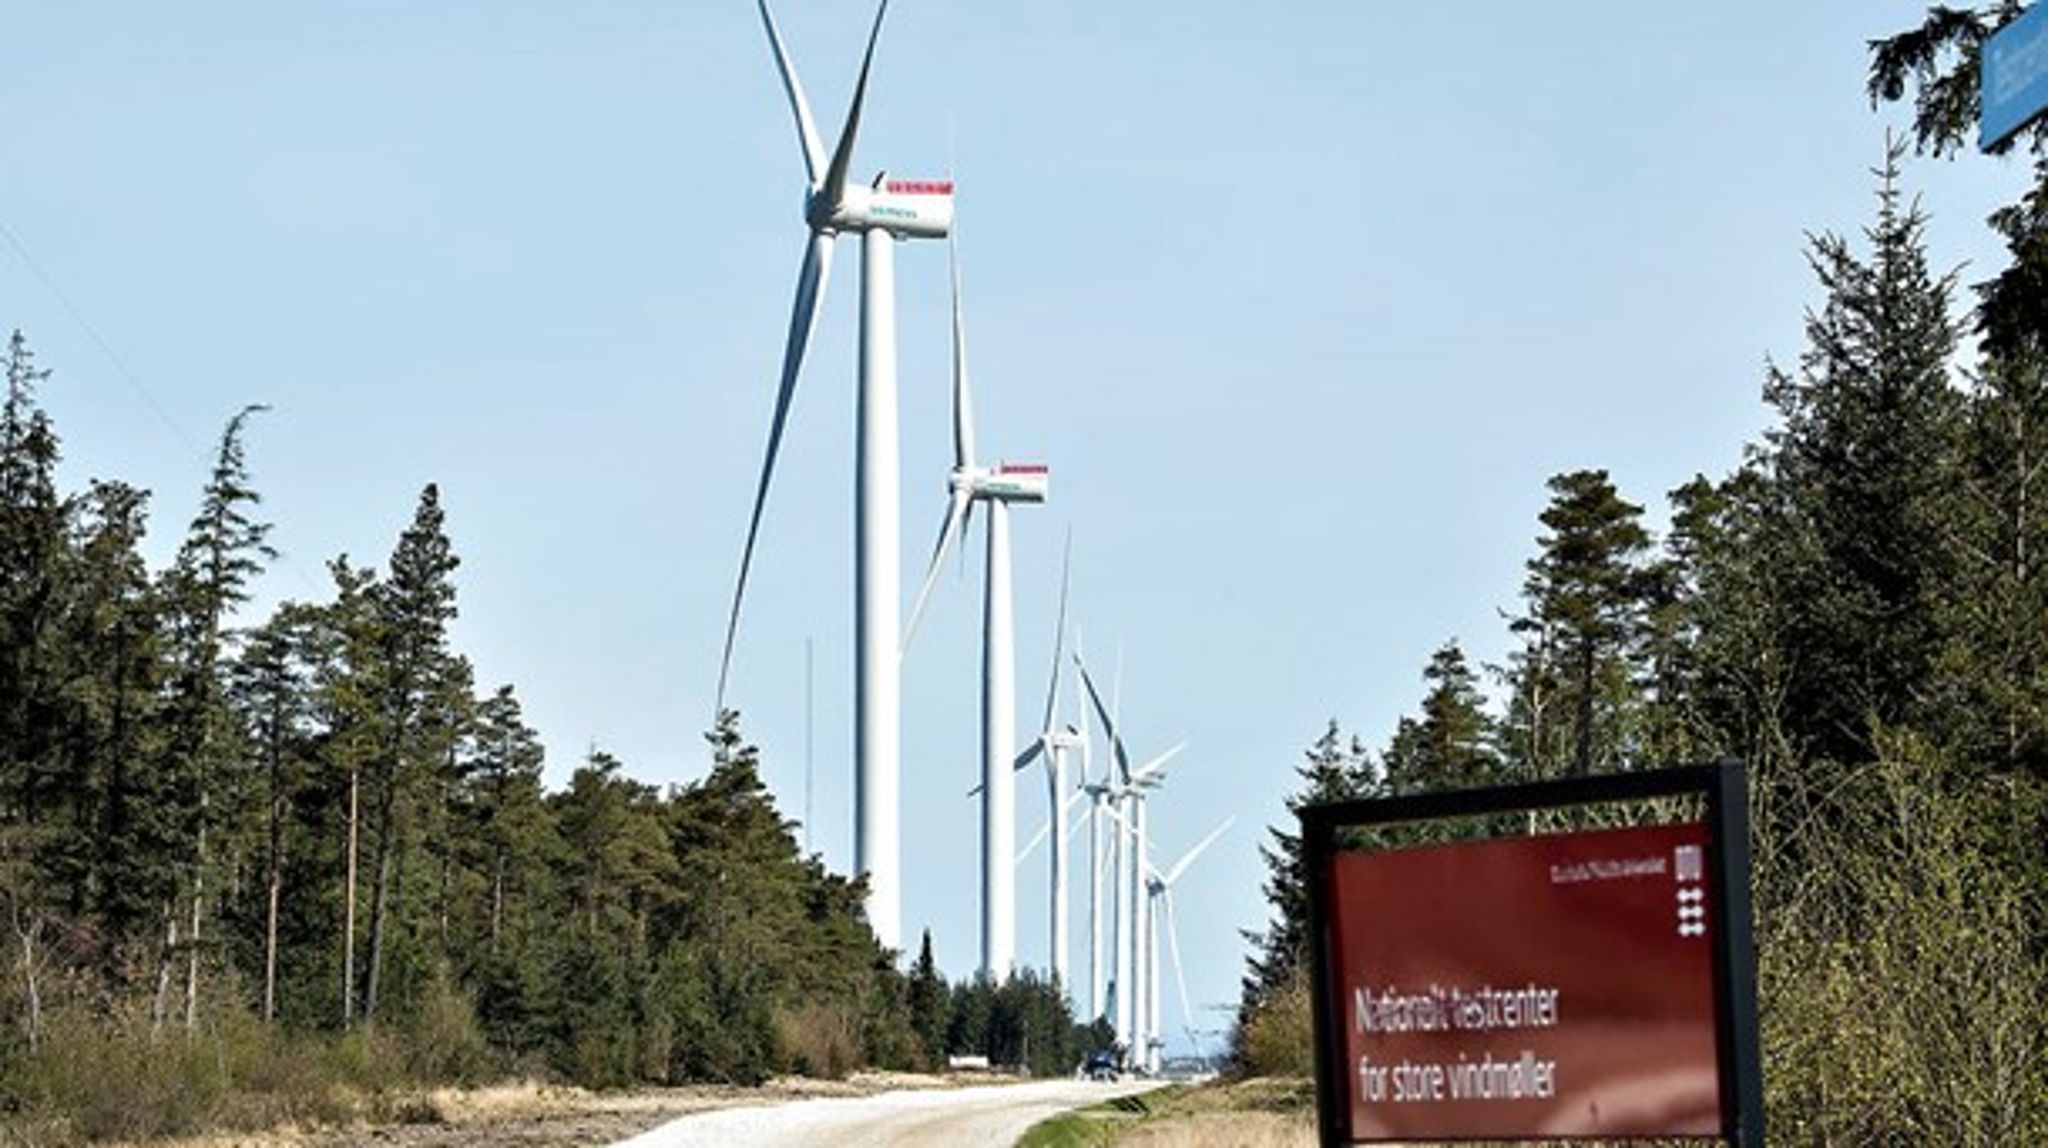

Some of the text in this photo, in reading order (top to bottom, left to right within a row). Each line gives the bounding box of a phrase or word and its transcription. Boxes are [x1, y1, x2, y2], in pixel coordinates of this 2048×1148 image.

[1355, 983, 1559, 1032] Nationalt testcenter
[1360, 1050, 1556, 1101] for store vindmøller
